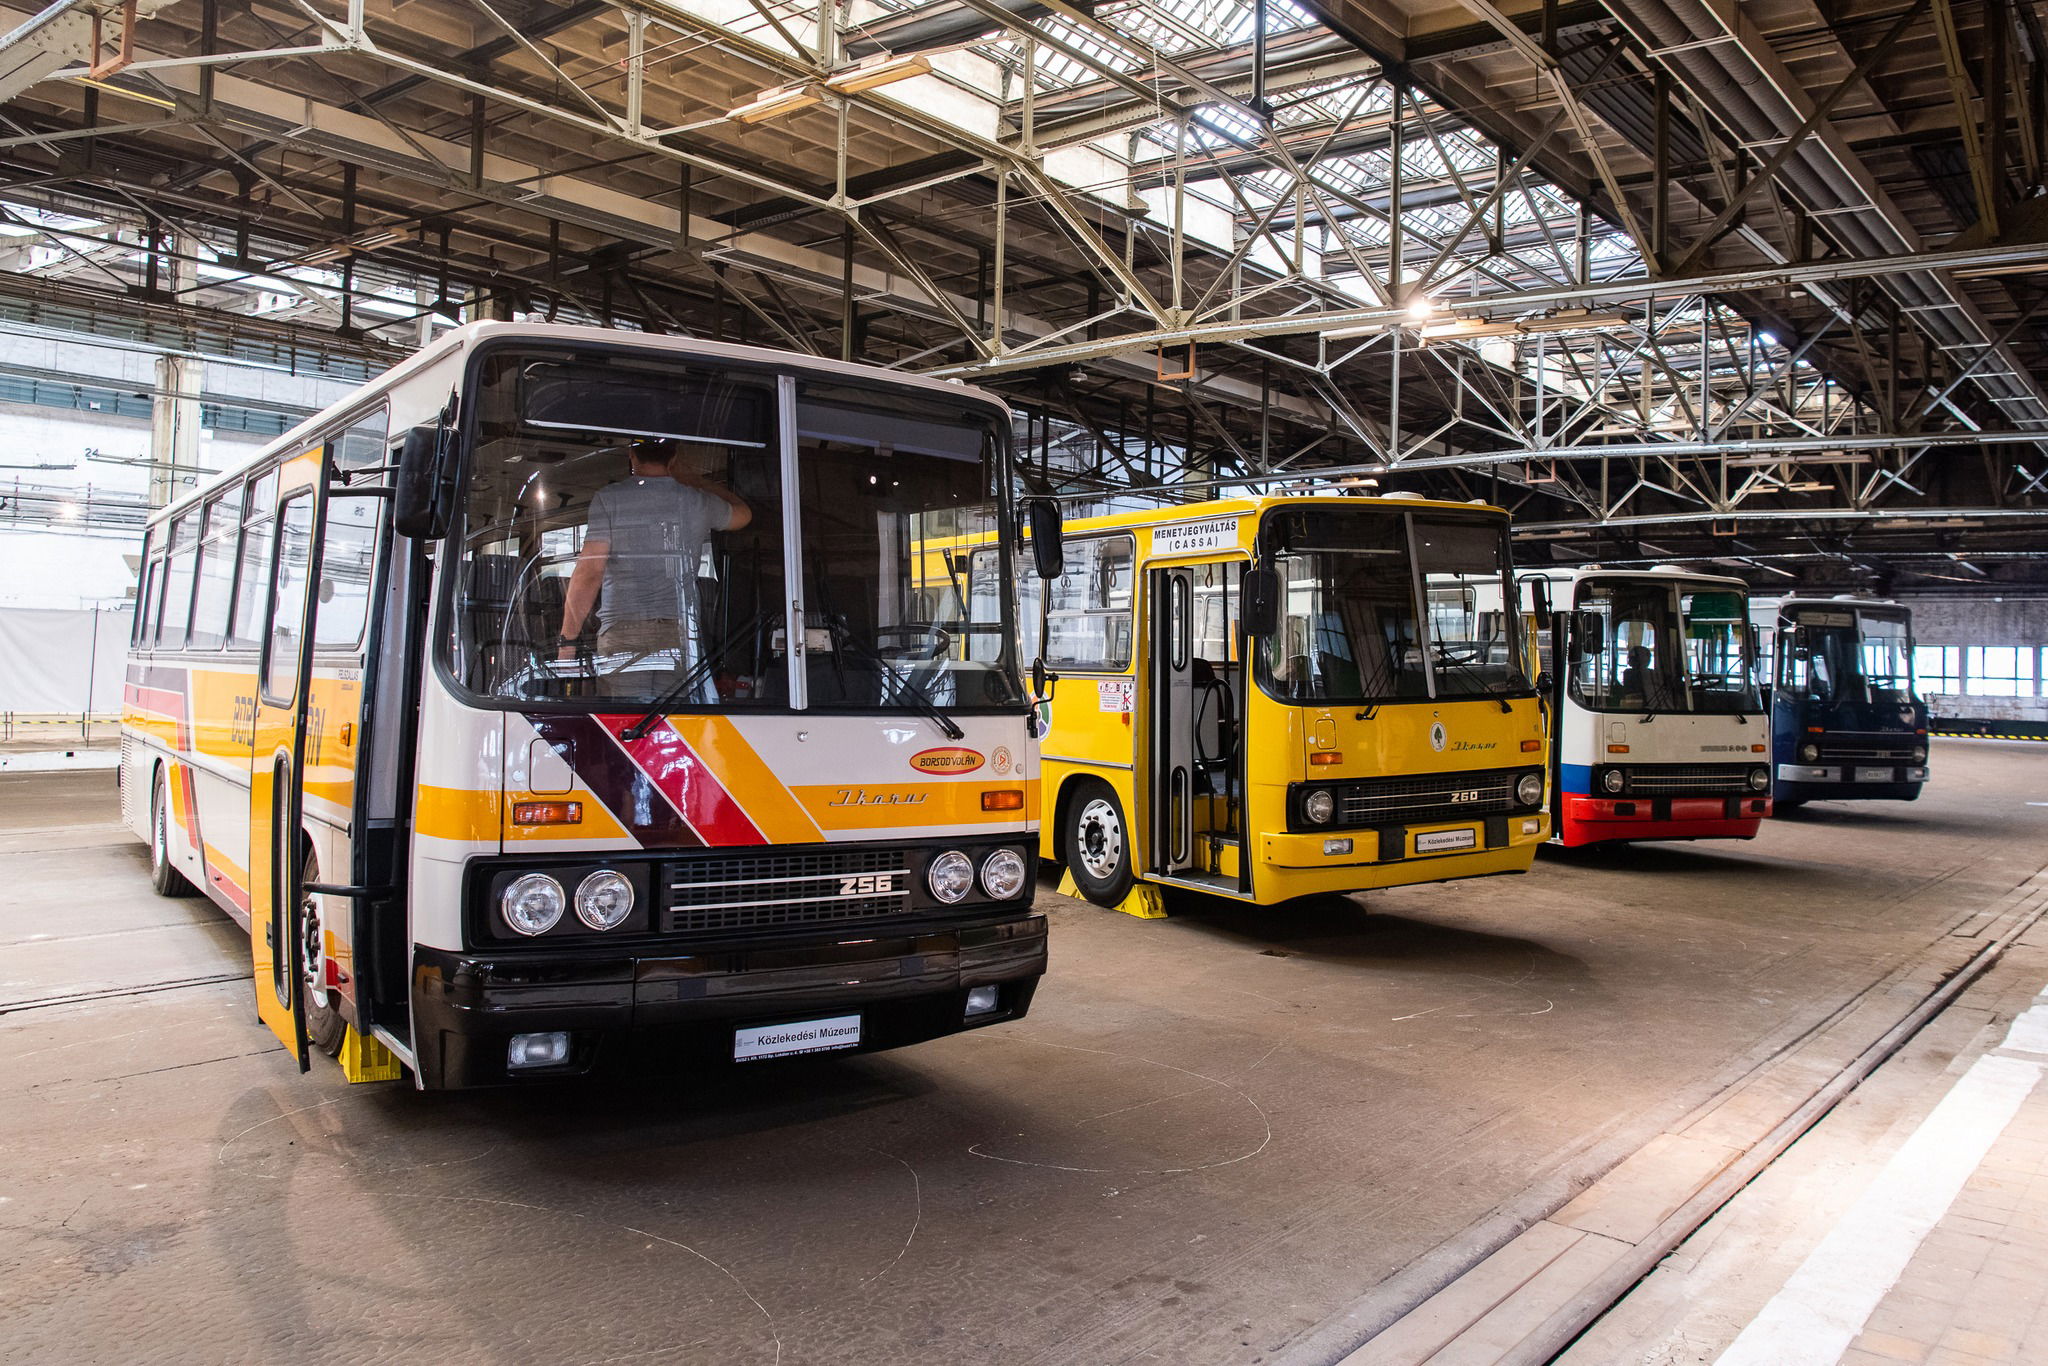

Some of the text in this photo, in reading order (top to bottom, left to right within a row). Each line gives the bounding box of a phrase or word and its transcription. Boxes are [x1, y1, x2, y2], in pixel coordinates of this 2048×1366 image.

[85, 448, 99, 457] 24
[1154, 520, 1236, 539] MENETJEGYVÁLTÁS
[1169, 536, 1218, 551] (CASSA)
[920, 755, 976, 767] BORSOD VOLÁN
[829, 789, 929, 807] Ikarus
[758, 1029, 817, 1046] Közlekedési
[819, 1025, 859, 1039] Múzeum
